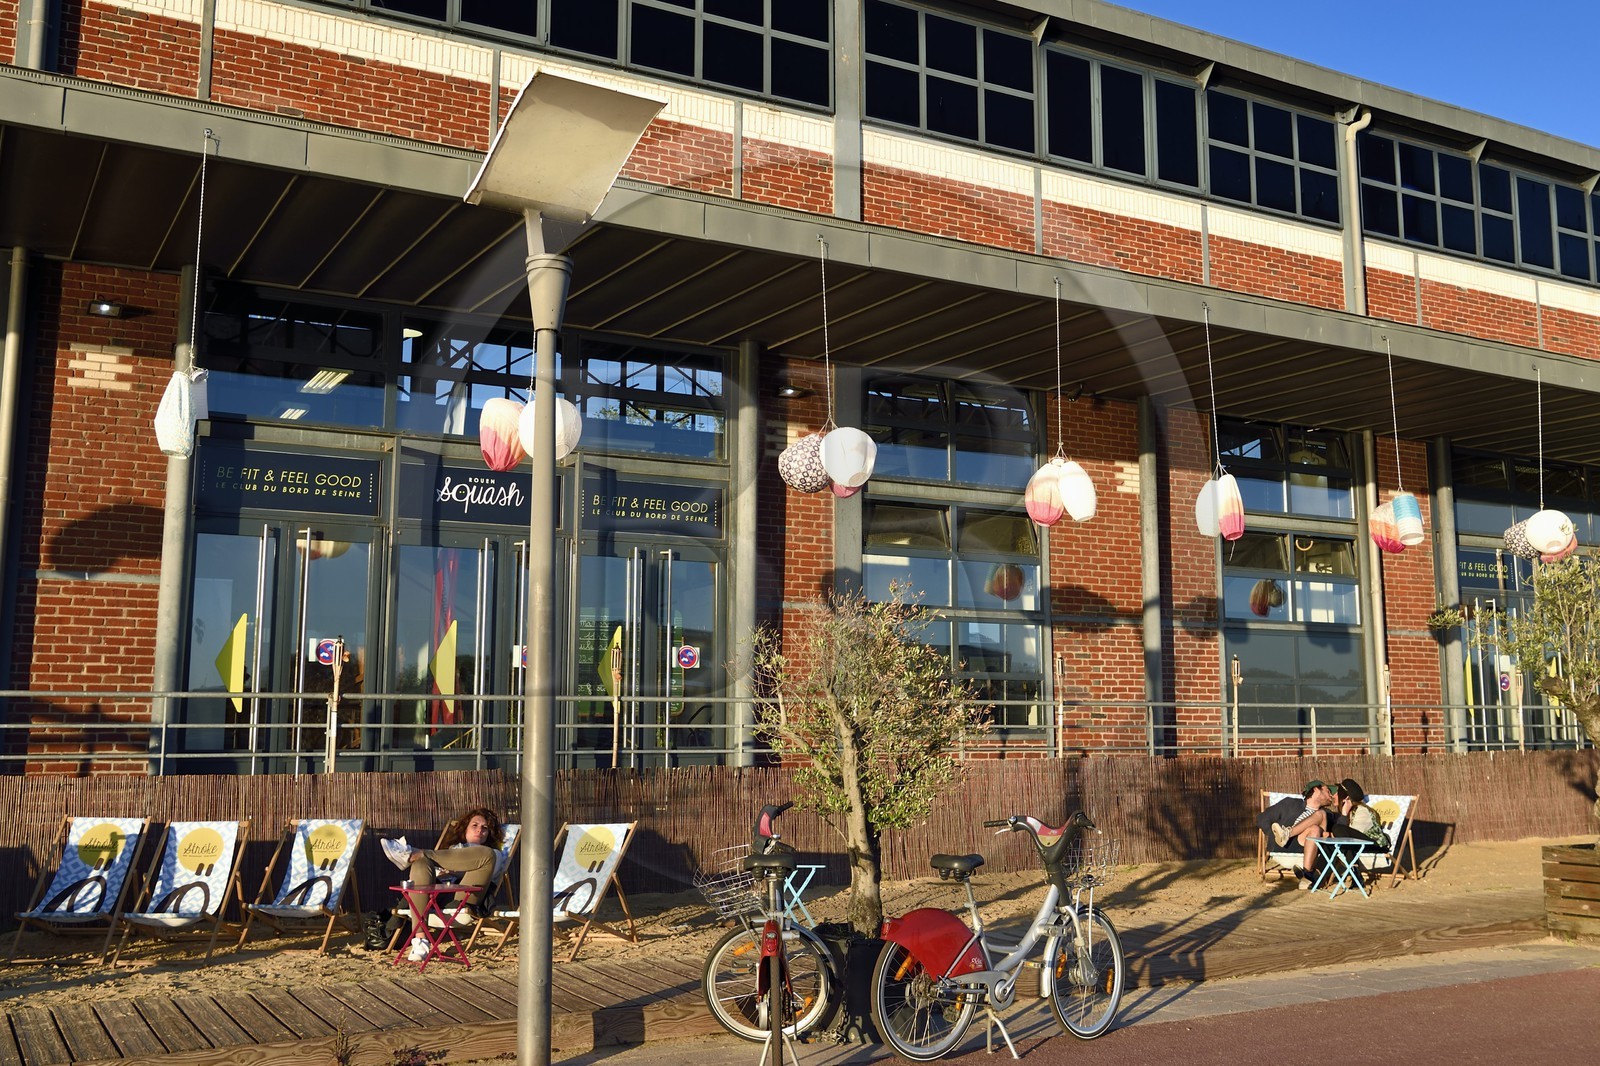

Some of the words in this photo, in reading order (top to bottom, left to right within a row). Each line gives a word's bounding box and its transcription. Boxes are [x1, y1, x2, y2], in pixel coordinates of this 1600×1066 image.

[216, 466, 234, 479] BE
[240, 467, 260, 480] FIT
[263, 469, 275, 482] &
[280, 470, 309, 485] FEEL
[315, 473, 362, 488] GOOD
[215, 481, 226, 489] LE
[232, 482, 257, 491] CLUB
[263, 484, 277, 492] DU
[282, 486, 309, 495] BORD
[315, 488, 327, 496] DE
[332, 489, 362, 498] SEINE
[592, 495, 606, 506] BE
[611, 496, 628, 508] FIT
[630, 497, 639, 509] &
[643, 498, 667, 511] FEEL
[671, 500, 709, 514] GOOD
[605, 509, 626, 517] CLUB
[645, 512, 667, 520] BORD
[685, 515, 709, 523] SEINE
[1468, 562, 1473, 570] &
[1474, 562, 1487, 571] FEEL
